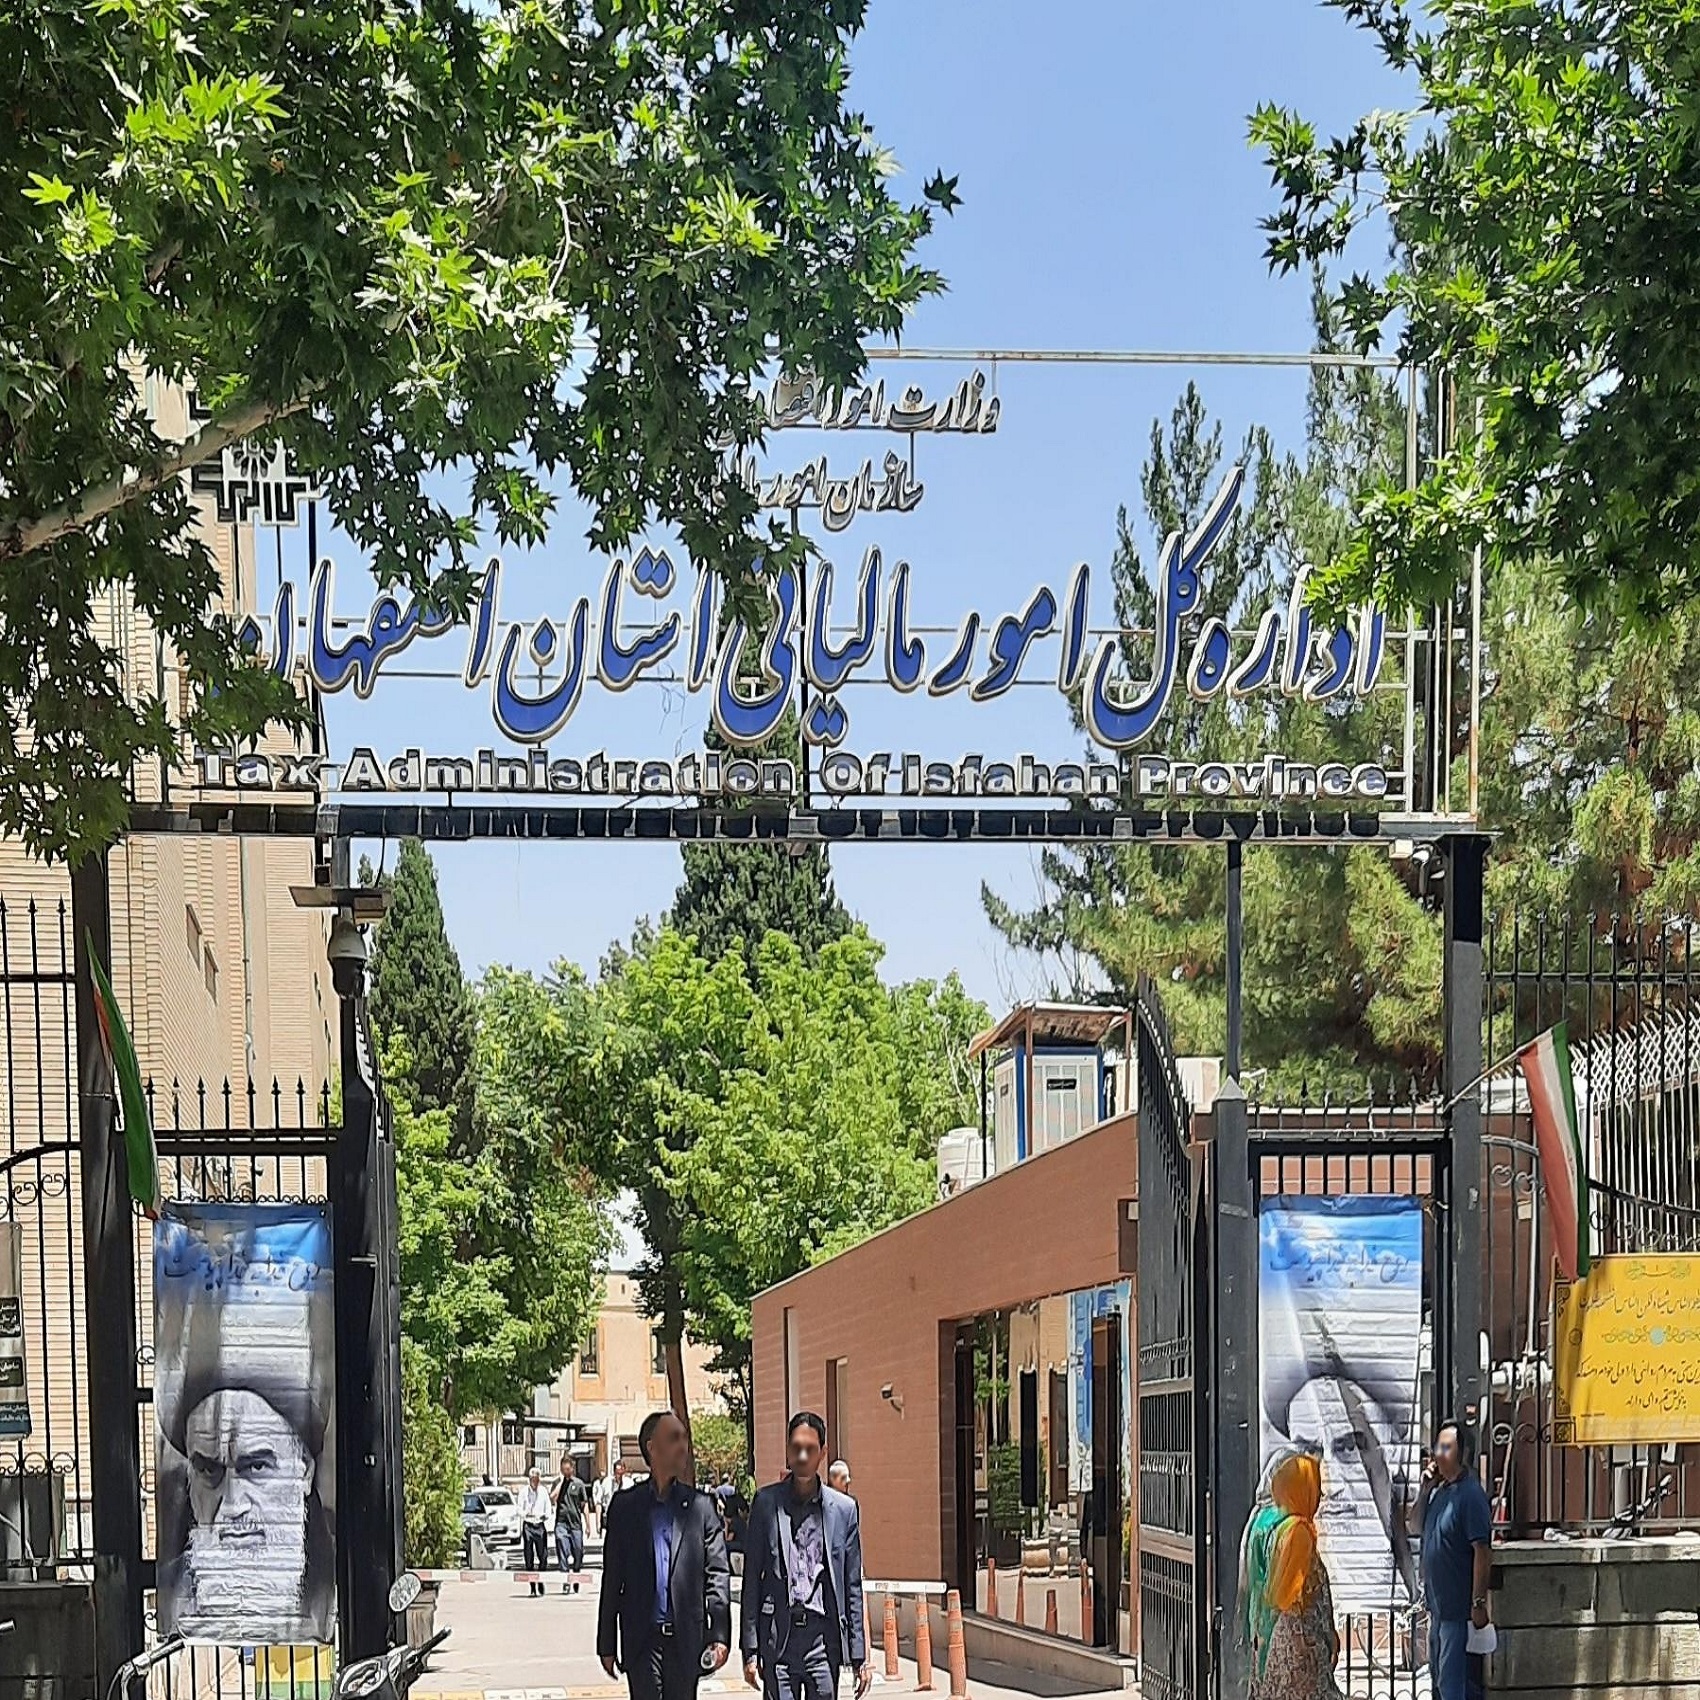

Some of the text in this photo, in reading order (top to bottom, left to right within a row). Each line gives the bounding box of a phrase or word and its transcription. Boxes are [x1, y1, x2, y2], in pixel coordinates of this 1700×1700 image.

[887, 368, 1000, 433] وزارت
[760, 455, 827, 508] امور
[822, 449, 924, 533] سازمان
[493, 546, 719, 743] استان
[711, 543, 927, 749] مالیاتی
[927, 560, 1092, 702] امور
[1082, 465, 1247, 750] کل
[1186, 561, 1387, 702] اداره
[194, 746, 320, 792] Tax
[820, 751, 891, 796] Of
[902, 753, 1119, 797] Isfahan
[1132, 754, 1388, 799] Province
